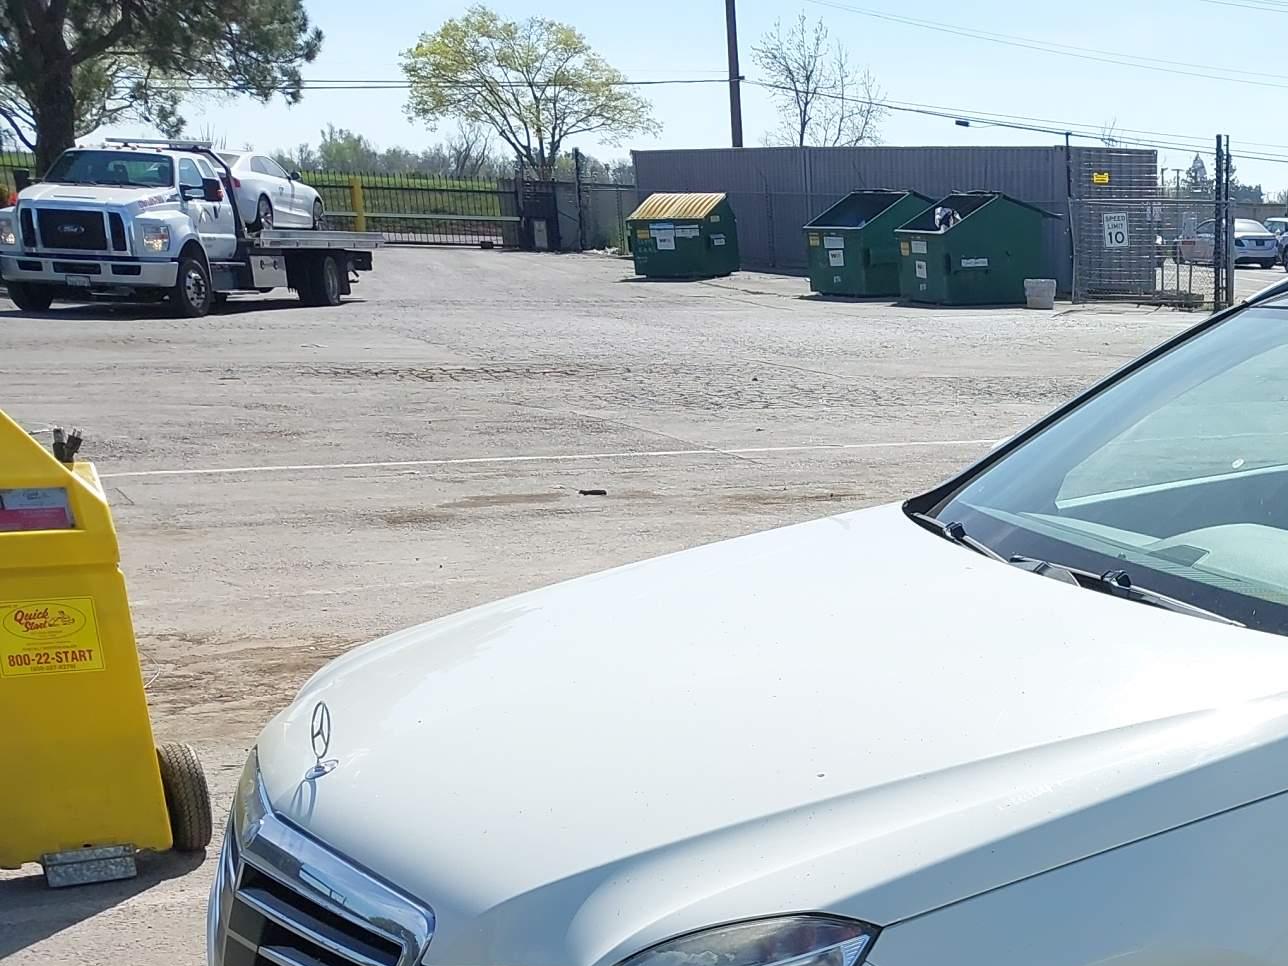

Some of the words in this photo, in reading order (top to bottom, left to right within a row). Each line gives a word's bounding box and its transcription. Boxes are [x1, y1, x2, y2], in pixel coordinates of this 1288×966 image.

[1108, 231, 1125, 244] 10
[14, 608, 49, 625] Quick
[8, 649, 93, 667] 800-22-START
